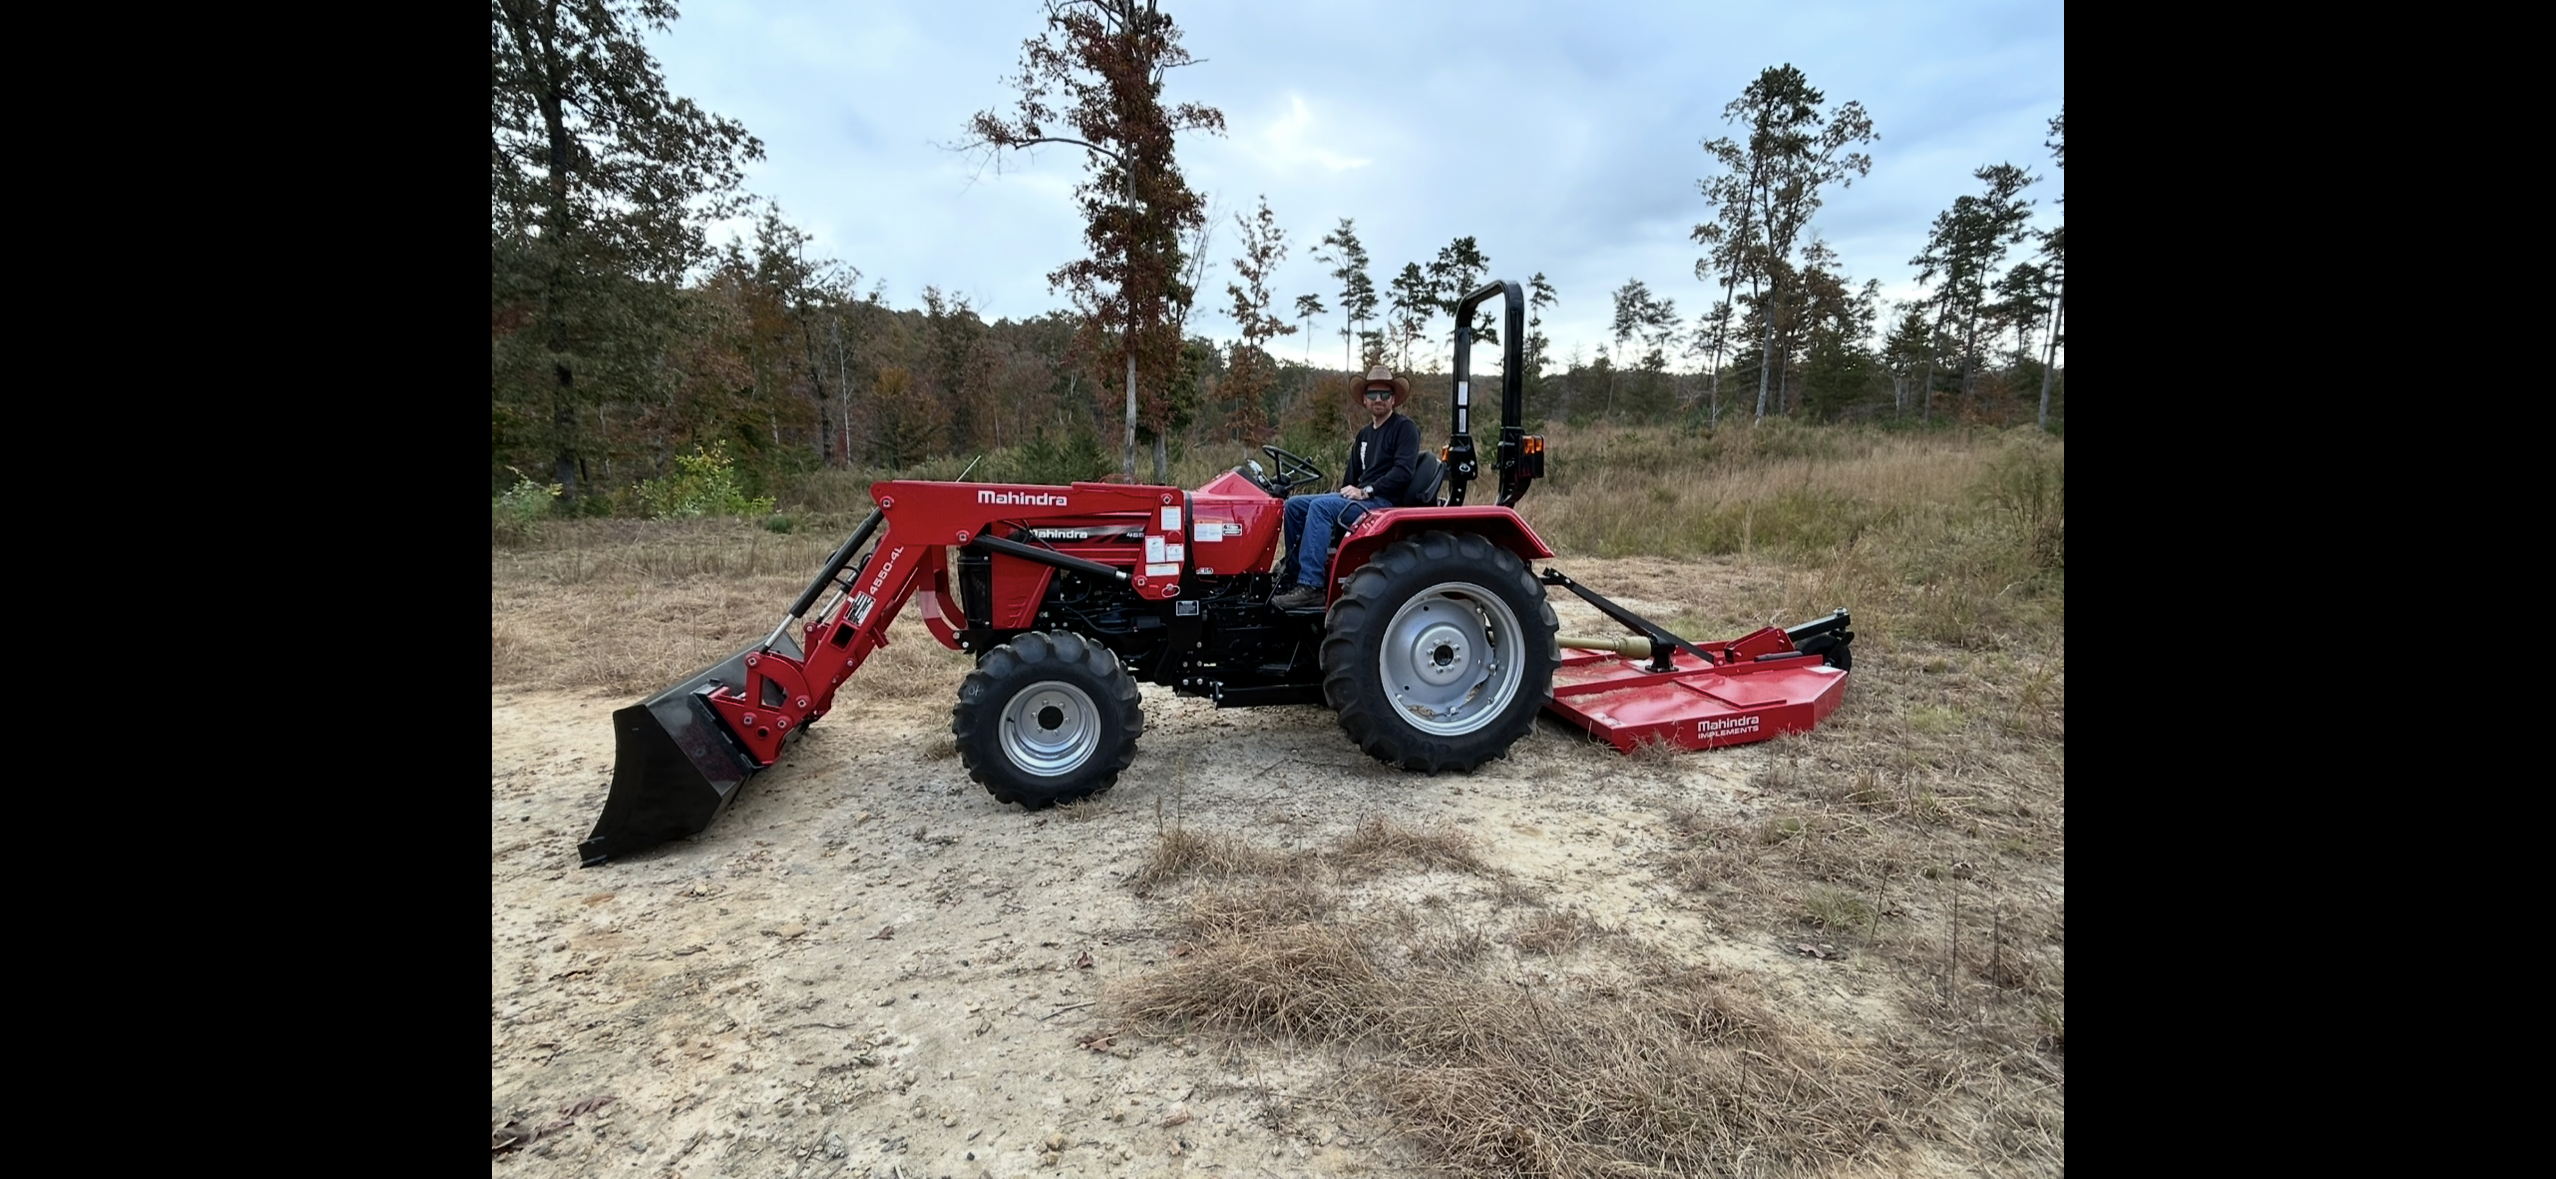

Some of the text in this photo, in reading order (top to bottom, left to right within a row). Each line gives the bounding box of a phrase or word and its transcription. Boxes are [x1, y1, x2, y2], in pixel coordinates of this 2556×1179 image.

[978, 490, 1068, 507] Mahindra
[1697, 715, 1760, 732] Mahindra
[1697, 725, 1760, 740] IMPLEMENTS
